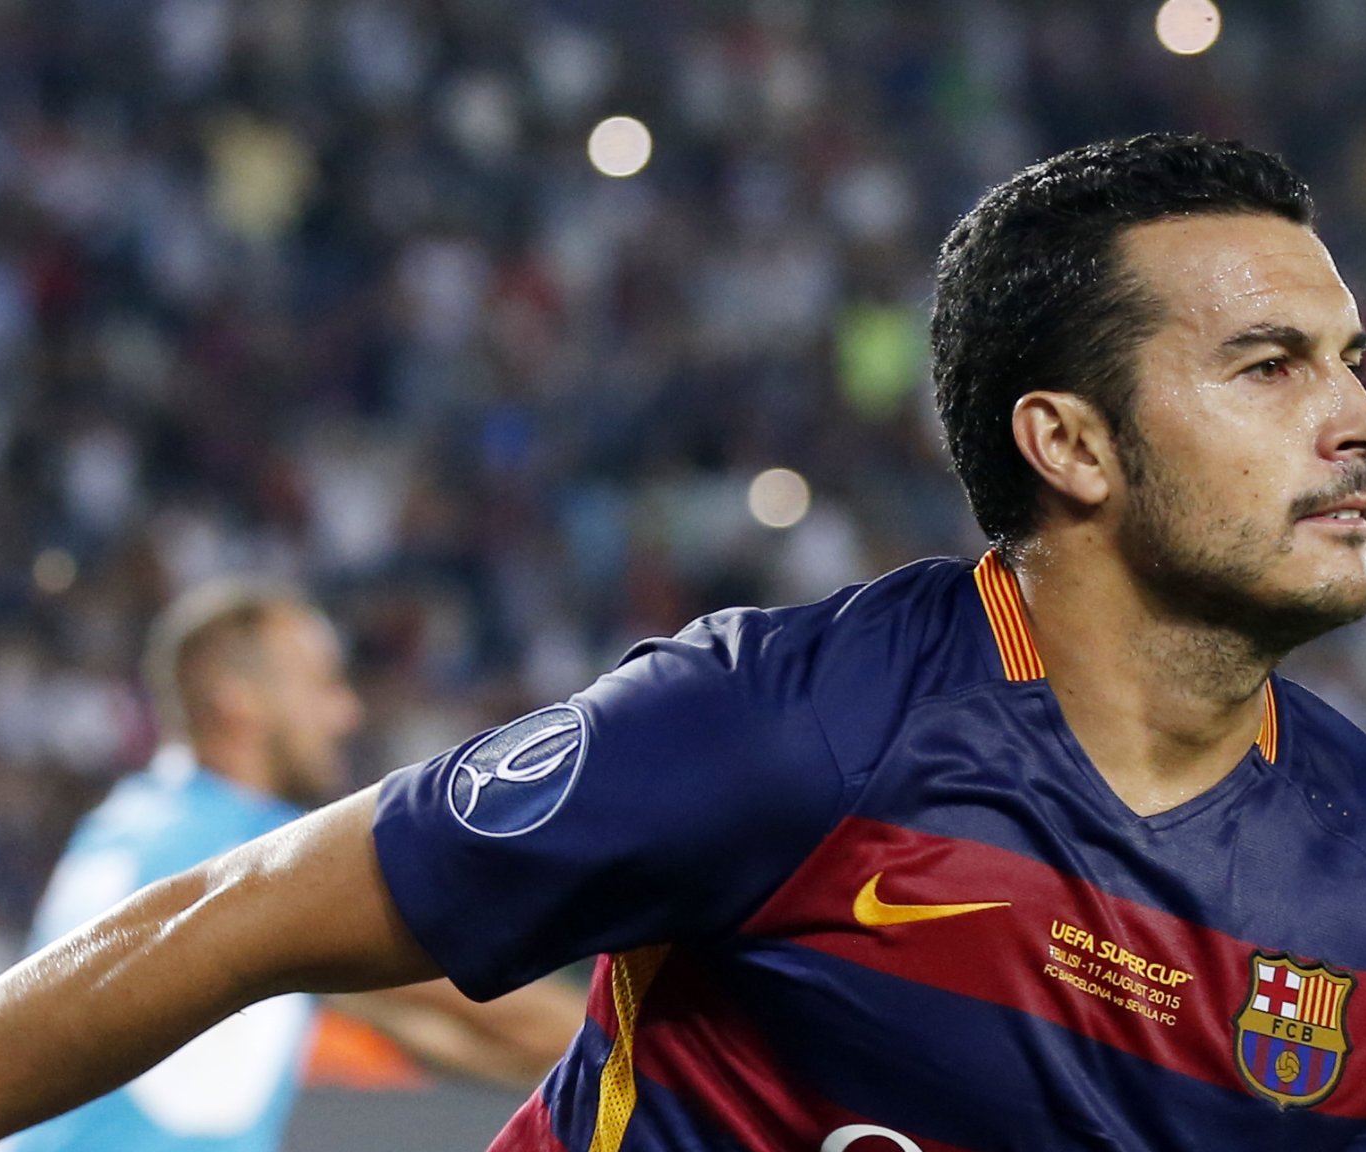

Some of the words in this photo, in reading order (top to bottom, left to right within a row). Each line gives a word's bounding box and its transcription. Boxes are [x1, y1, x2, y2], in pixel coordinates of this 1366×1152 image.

[1051, 920, 1094, 953] UEFA
[1097, 941, 1147, 977] SUPER
[1043, 964, 1059, 977] FC
[1058, 969, 1111, 1000] BARCELONA
[1160, 1012, 1177, 1026] FC
[1088, 962, 1102, 977] 11
[1101, 970, 1148, 998] AUGUST
[1148, 989, 1181, 1009] 2015
